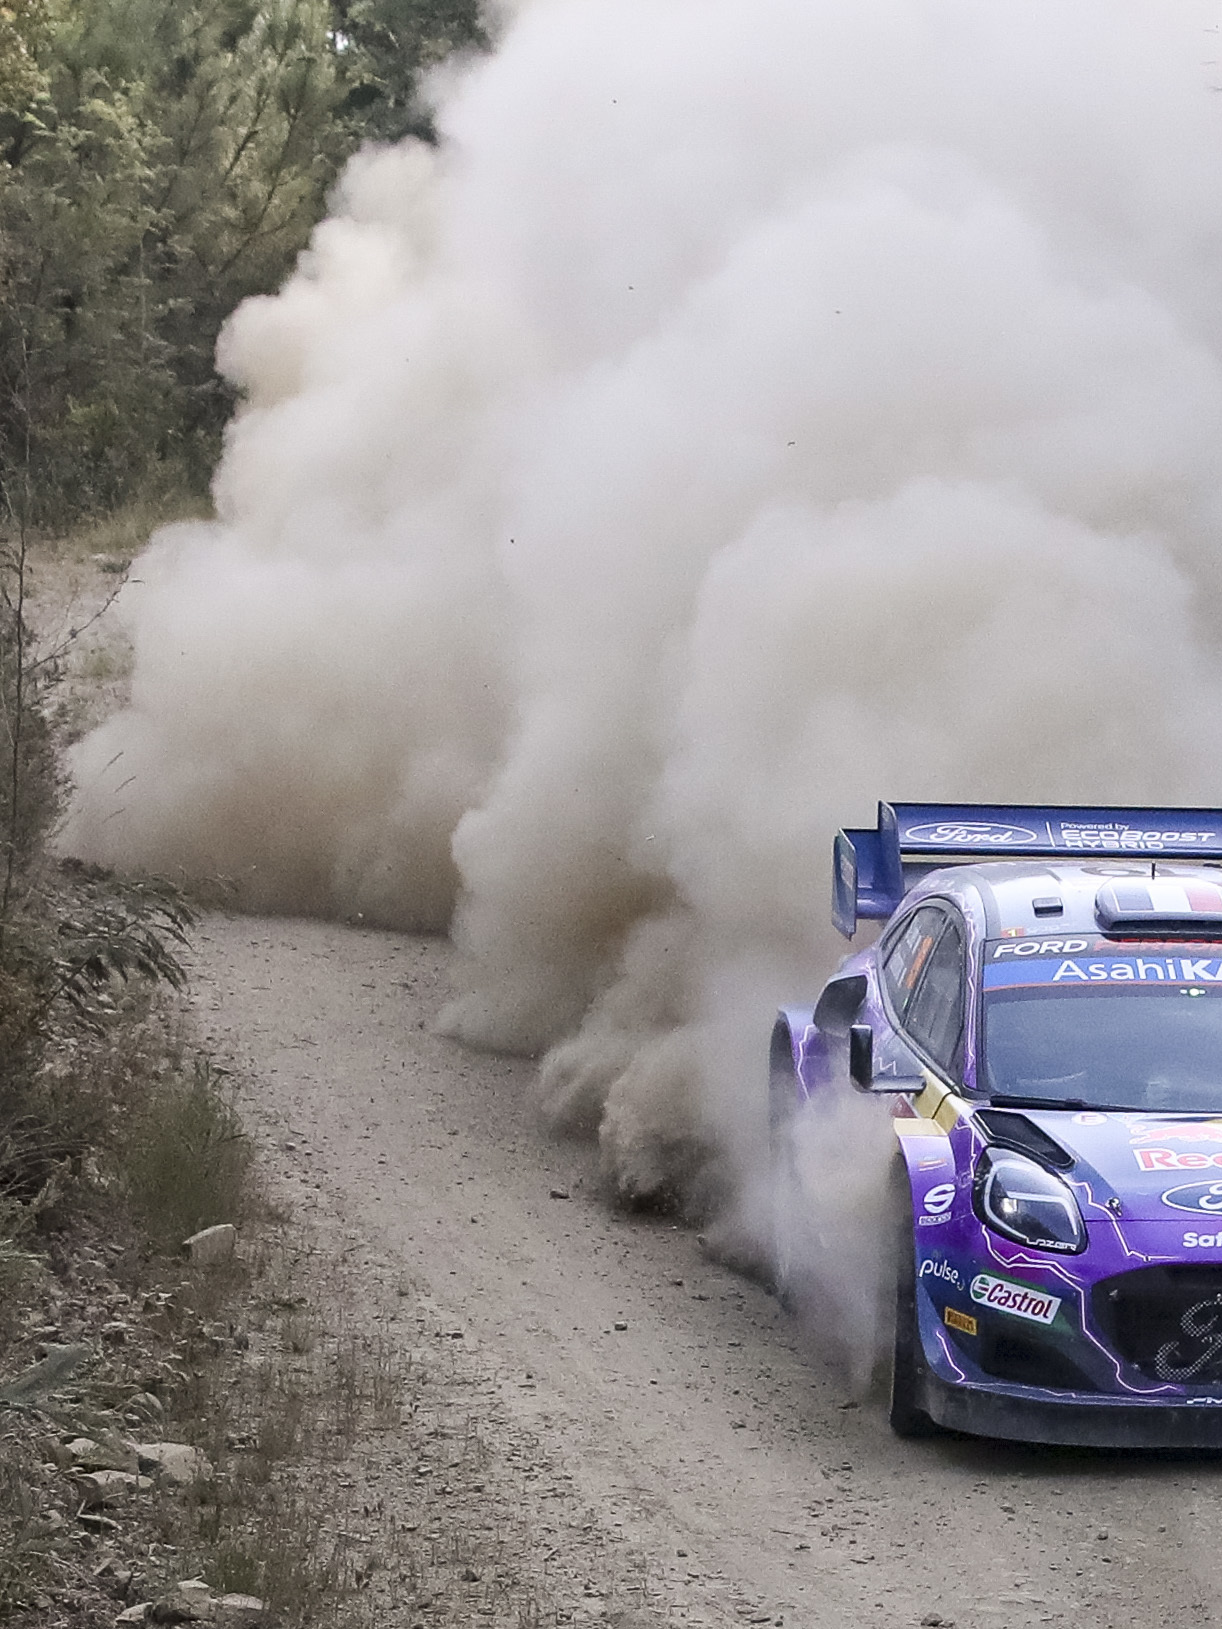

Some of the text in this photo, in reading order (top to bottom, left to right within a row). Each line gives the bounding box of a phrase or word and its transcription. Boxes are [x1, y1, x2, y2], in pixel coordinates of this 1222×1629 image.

[930, 824, 1013, 843] Ford
[1060, 822, 1130, 831] Powered by
[1061, 829, 1217, 843] ECOBOOST
[1065, 839, 1165, 849] HYBRID
[993, 939, 1089, 958] FORD
[919, 1259, 958, 1283] pulse
[986, 1283, 1053, 1319] Castrol
